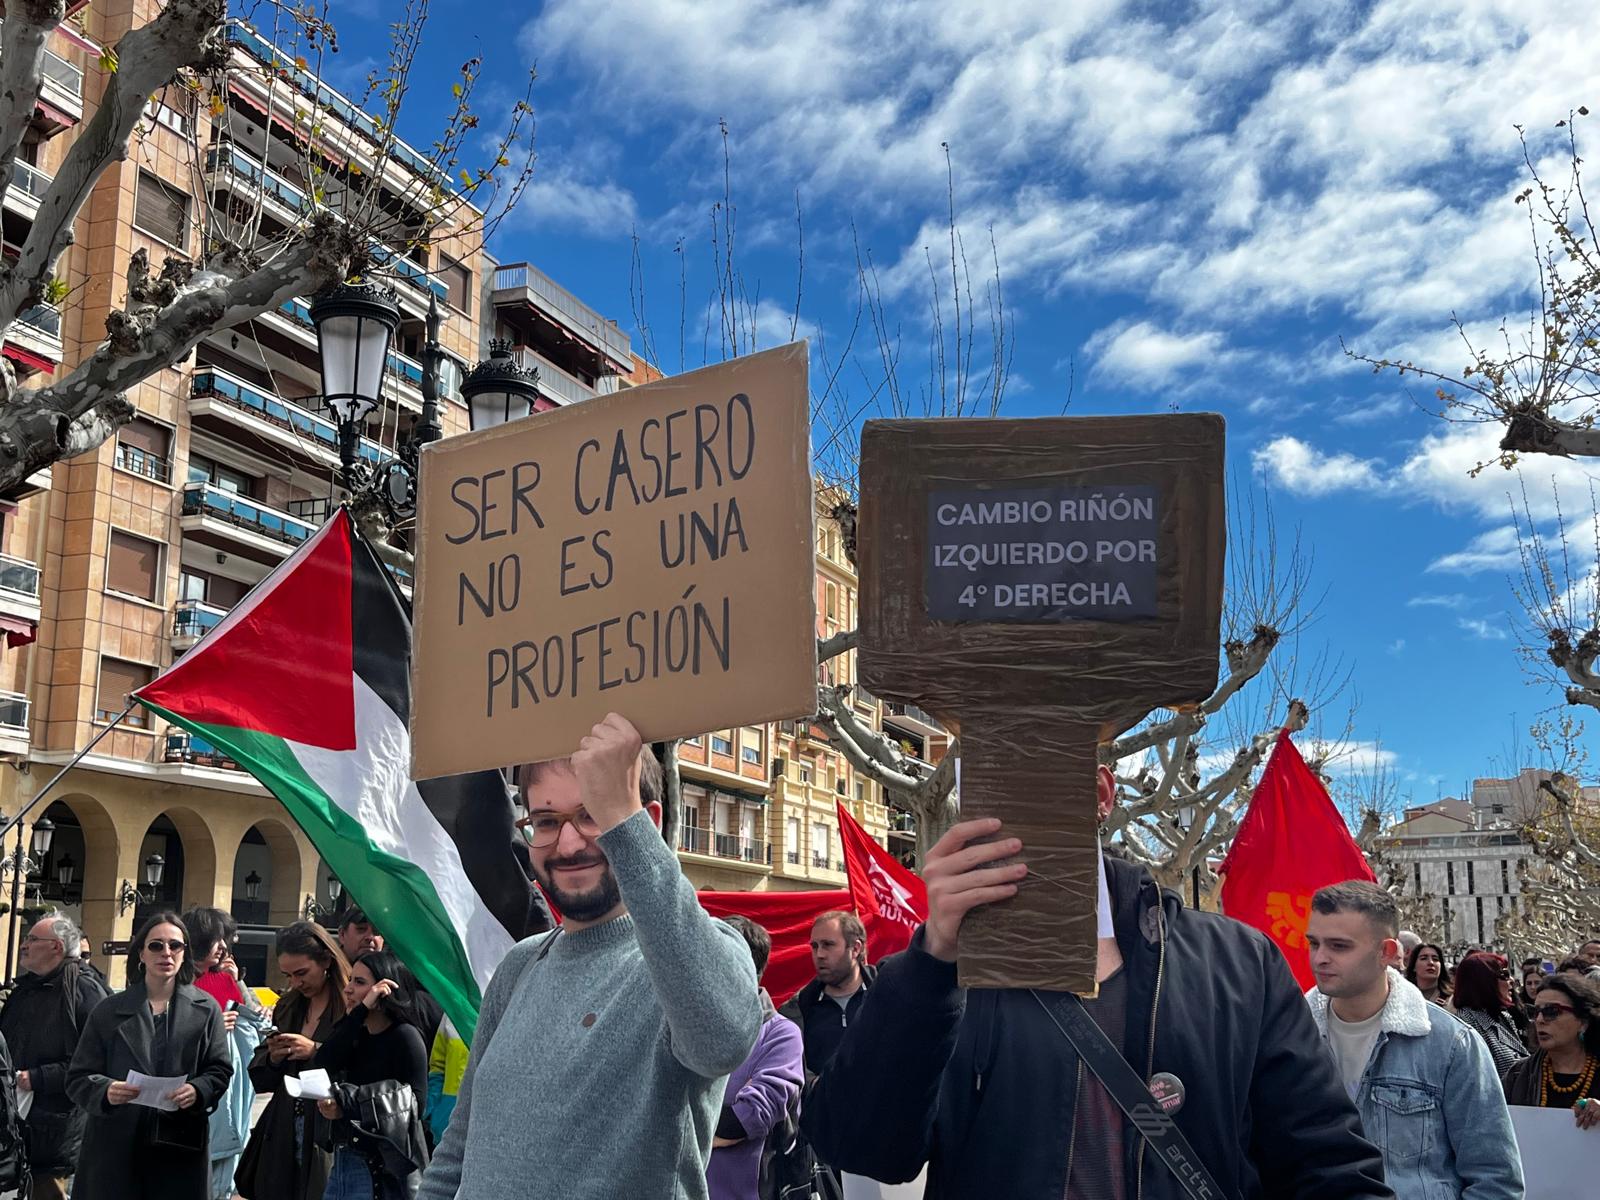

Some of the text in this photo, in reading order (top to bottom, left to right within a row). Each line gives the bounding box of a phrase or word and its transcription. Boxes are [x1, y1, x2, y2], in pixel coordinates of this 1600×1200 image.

[445, 393, 756, 545] SER CASERO
[937, 492, 1153, 526] CAMBIO RIÑÓN
[458, 497, 749, 626] NO ES UNA
[934, 540, 1157, 572] IZQUIERDO POR
[994, 582, 1132, 607] DERECHA
[487, 584, 730, 718] PROFESIÓN
